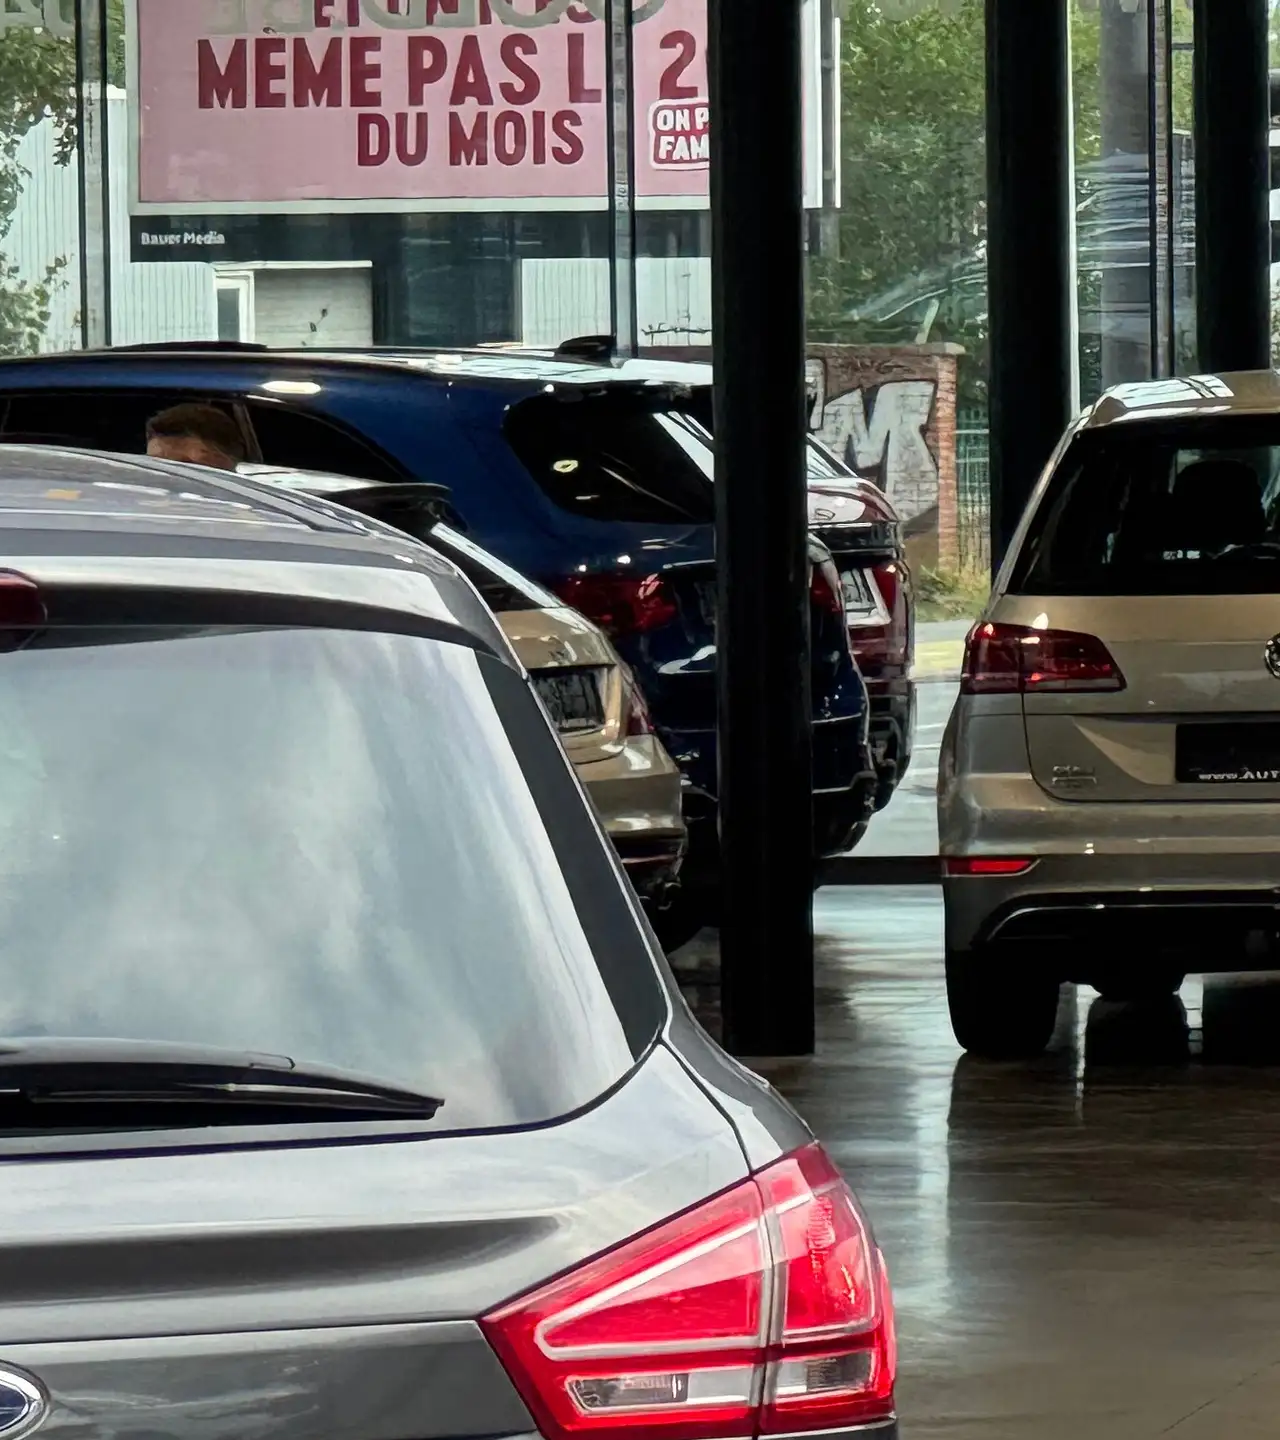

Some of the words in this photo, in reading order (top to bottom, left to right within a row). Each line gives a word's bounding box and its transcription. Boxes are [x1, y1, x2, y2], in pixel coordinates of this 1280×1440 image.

[407, 33, 541, 107] PAS
[567, 33, 602, 104] L
[659, 30, 699, 99] 2
[656, 109, 691, 132] ON
[694, 107, 709, 131] P
[357, 112, 428, 168] DU
[447, 110, 585, 167] MOIS
[658, 135, 709, 161] FAM
[183, 230, 226, 246] Media
